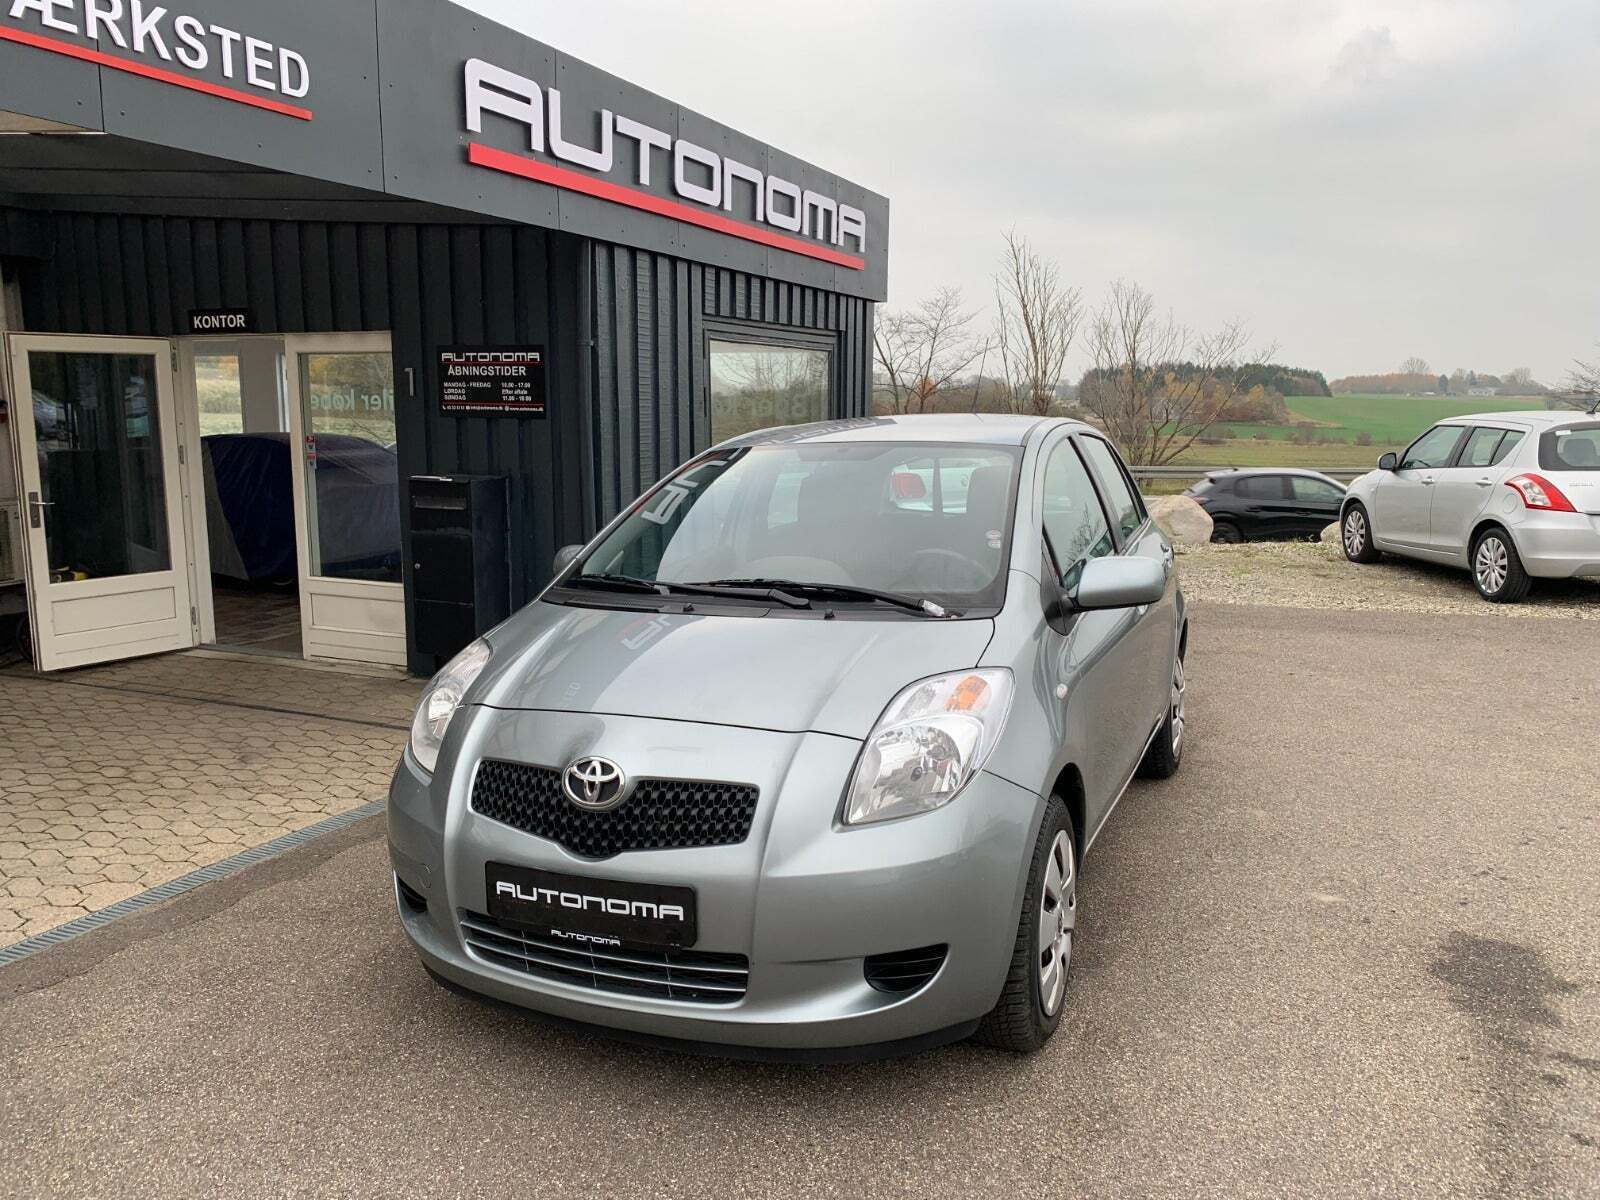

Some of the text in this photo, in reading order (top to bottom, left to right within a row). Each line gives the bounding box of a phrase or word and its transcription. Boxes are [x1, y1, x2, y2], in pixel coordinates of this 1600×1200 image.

[464, 57, 867, 253] AUTONOMA
[193, 314, 246, 329] KONTOR
[441, 352, 540, 361] AUTONOMA
[447, 364, 527, 376] ÅBNINGSTIDER
[496, 881, 684, 921] AUTONOMA
[551, 929, 621, 946] AUTONOMA
